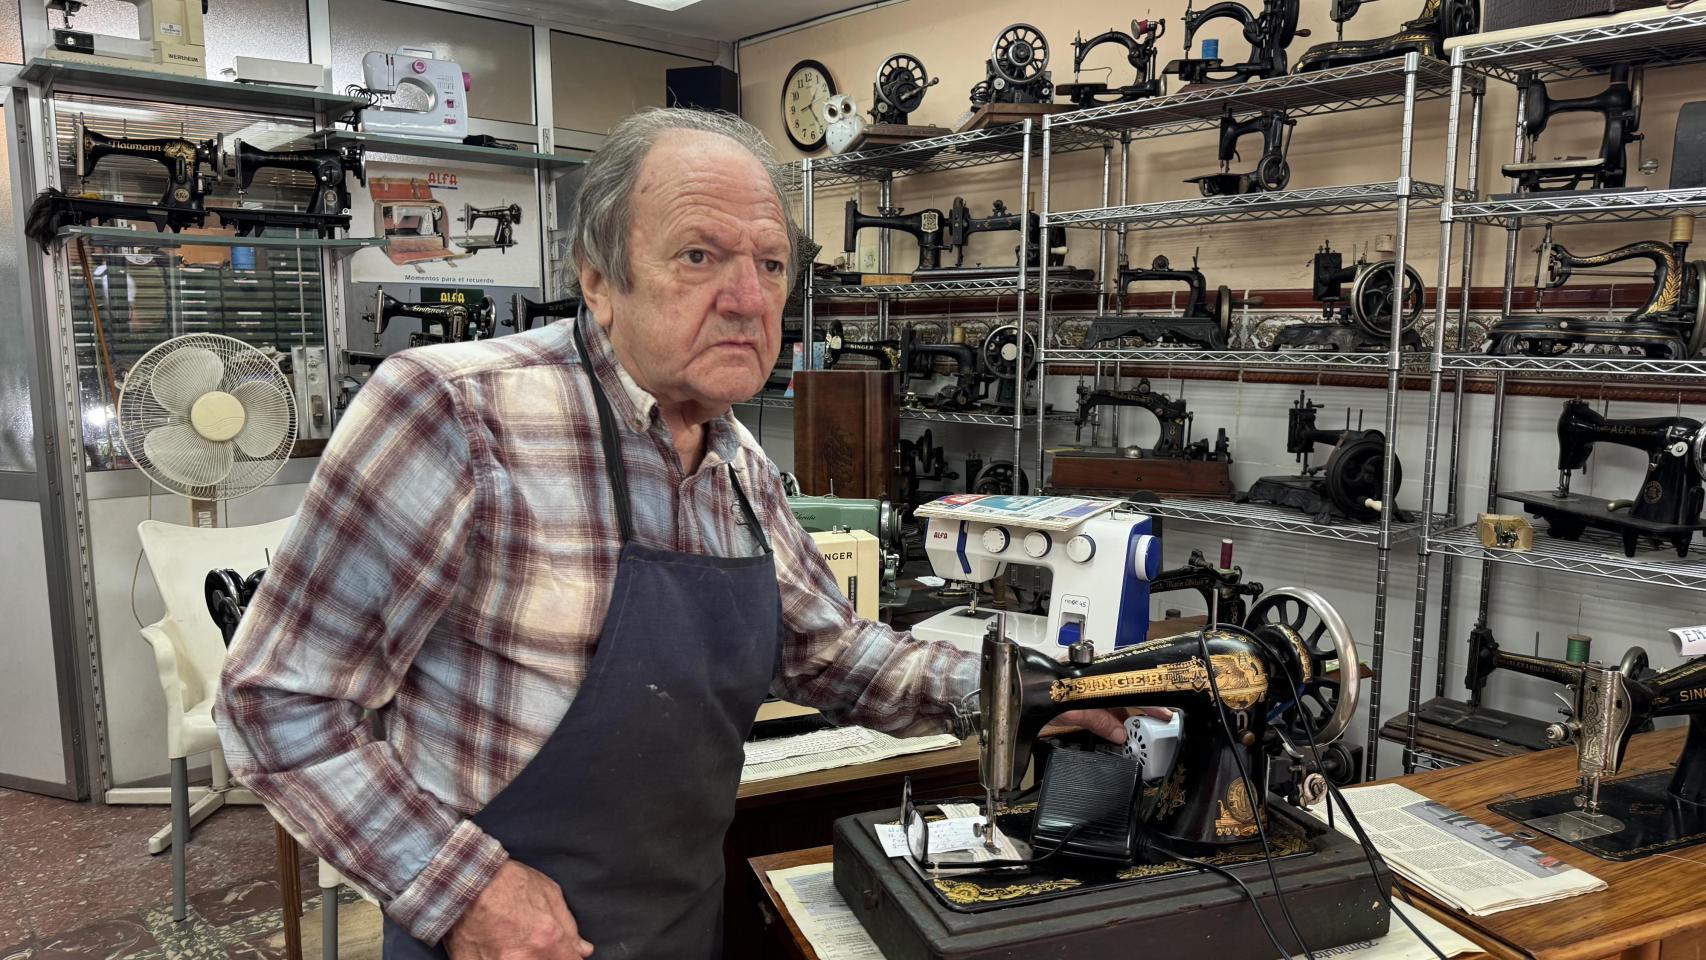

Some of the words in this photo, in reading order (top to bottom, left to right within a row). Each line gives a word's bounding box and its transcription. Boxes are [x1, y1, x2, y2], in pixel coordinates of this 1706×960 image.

[804, 72, 813, 83] 12
[816, 75, 819, 84] 1
[797, 80, 804, 88] 11
[792, 91, 799, 101] 10
[791, 106, 796, 115] 9
[794, 120, 800, 129] 8
[802, 129, 807, 138] 7
[810, 131, 816, 140] 6
[428, 171, 457, 186] ALFA
[404, 274, 439, 282] Momentos
[440, 292, 465, 304] ALFA
[933, 531, 948, 540] ALFA
[824, 551, 853, 561] NGER
[1076, 671, 1164, 694] SINGER
